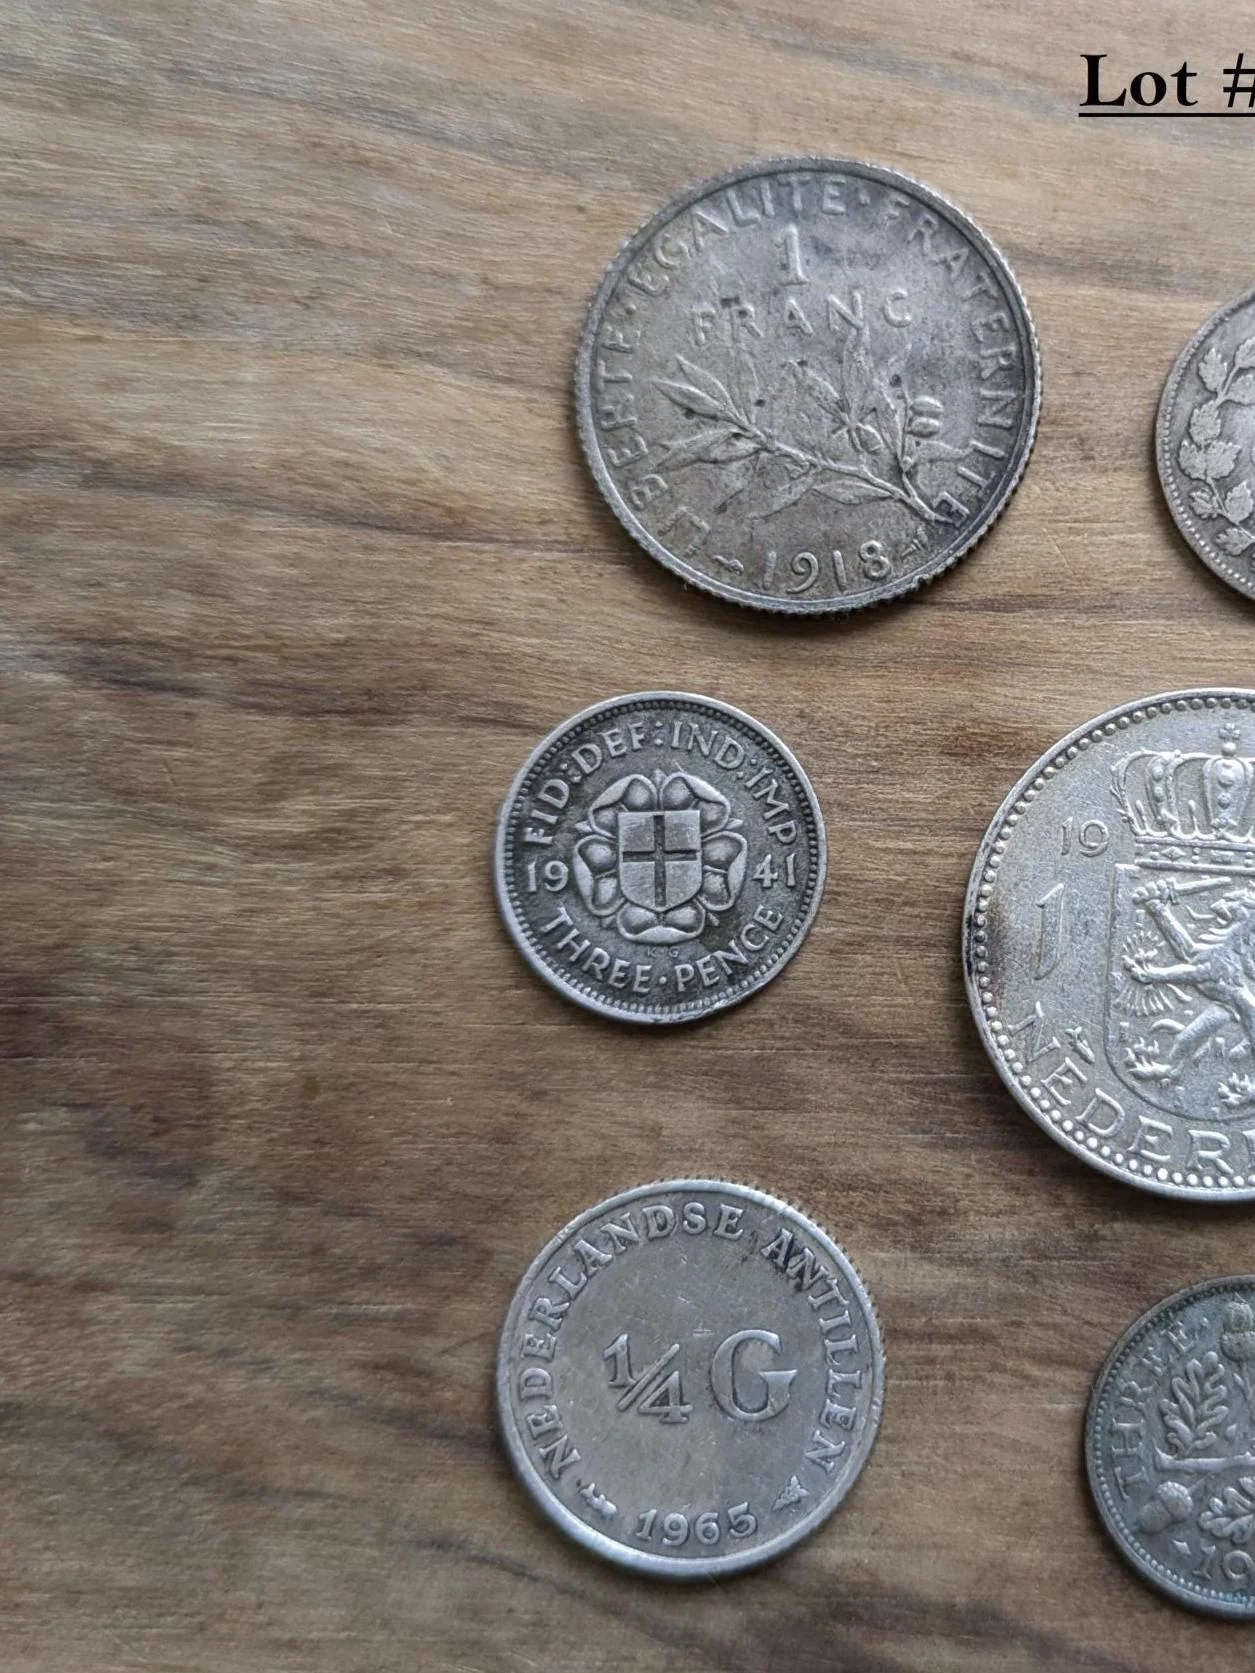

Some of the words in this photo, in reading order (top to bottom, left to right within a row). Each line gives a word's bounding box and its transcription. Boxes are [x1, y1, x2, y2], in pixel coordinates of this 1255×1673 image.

[773, 223, 810, 287] 1
[692, 289, 912, 346] FRANC
[761, 538, 895, 595] 1918
[1060, 816, 1109, 857] 19
[527, 859, 569, 893] 19
[752, 852, 798, 889] 41
[542, 905, 652, 994] THREE
[675, 903, 784, 994] PENCE
[519, 1201, 746, 1482] NEDERLANDSE
[760, 1226, 864, 1476] ANTILLEN
[710, 1328, 798, 1422] G
[636, 1501, 759, 1547] 1965
